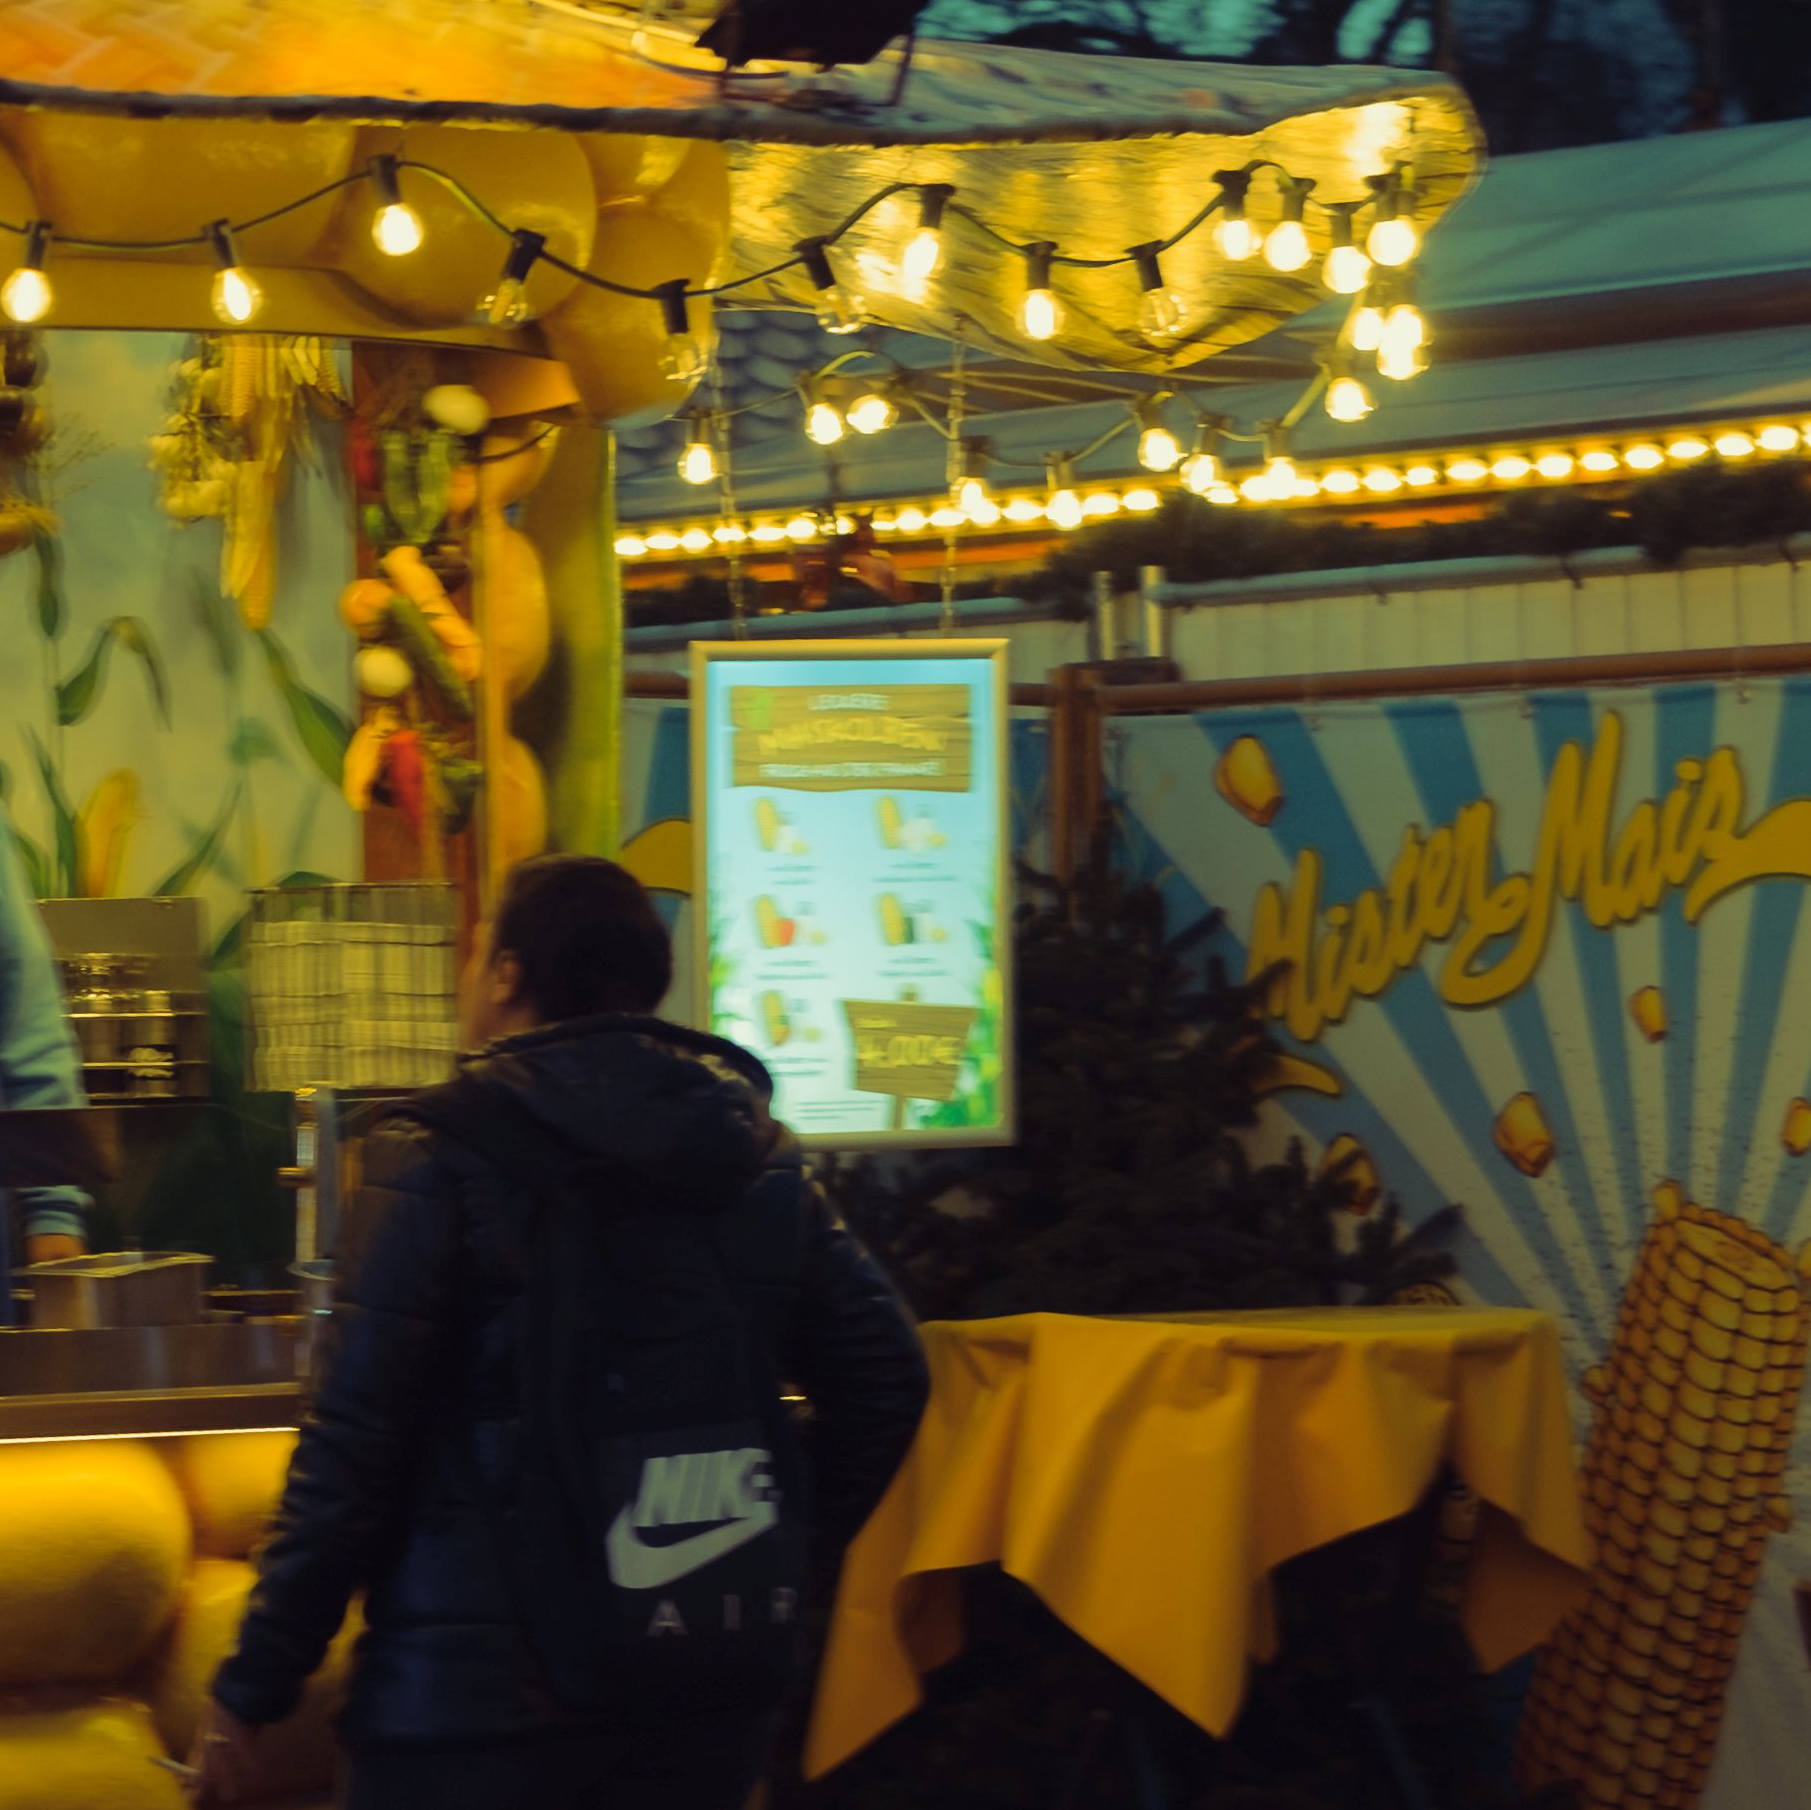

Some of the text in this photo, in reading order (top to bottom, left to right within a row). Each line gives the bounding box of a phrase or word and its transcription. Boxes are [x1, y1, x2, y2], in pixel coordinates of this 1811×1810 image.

[1242, 799, 1496, 1095] Mister
[634, 1448, 777, 1527] NIKE
[646, 1587, 798, 1637] AIR
